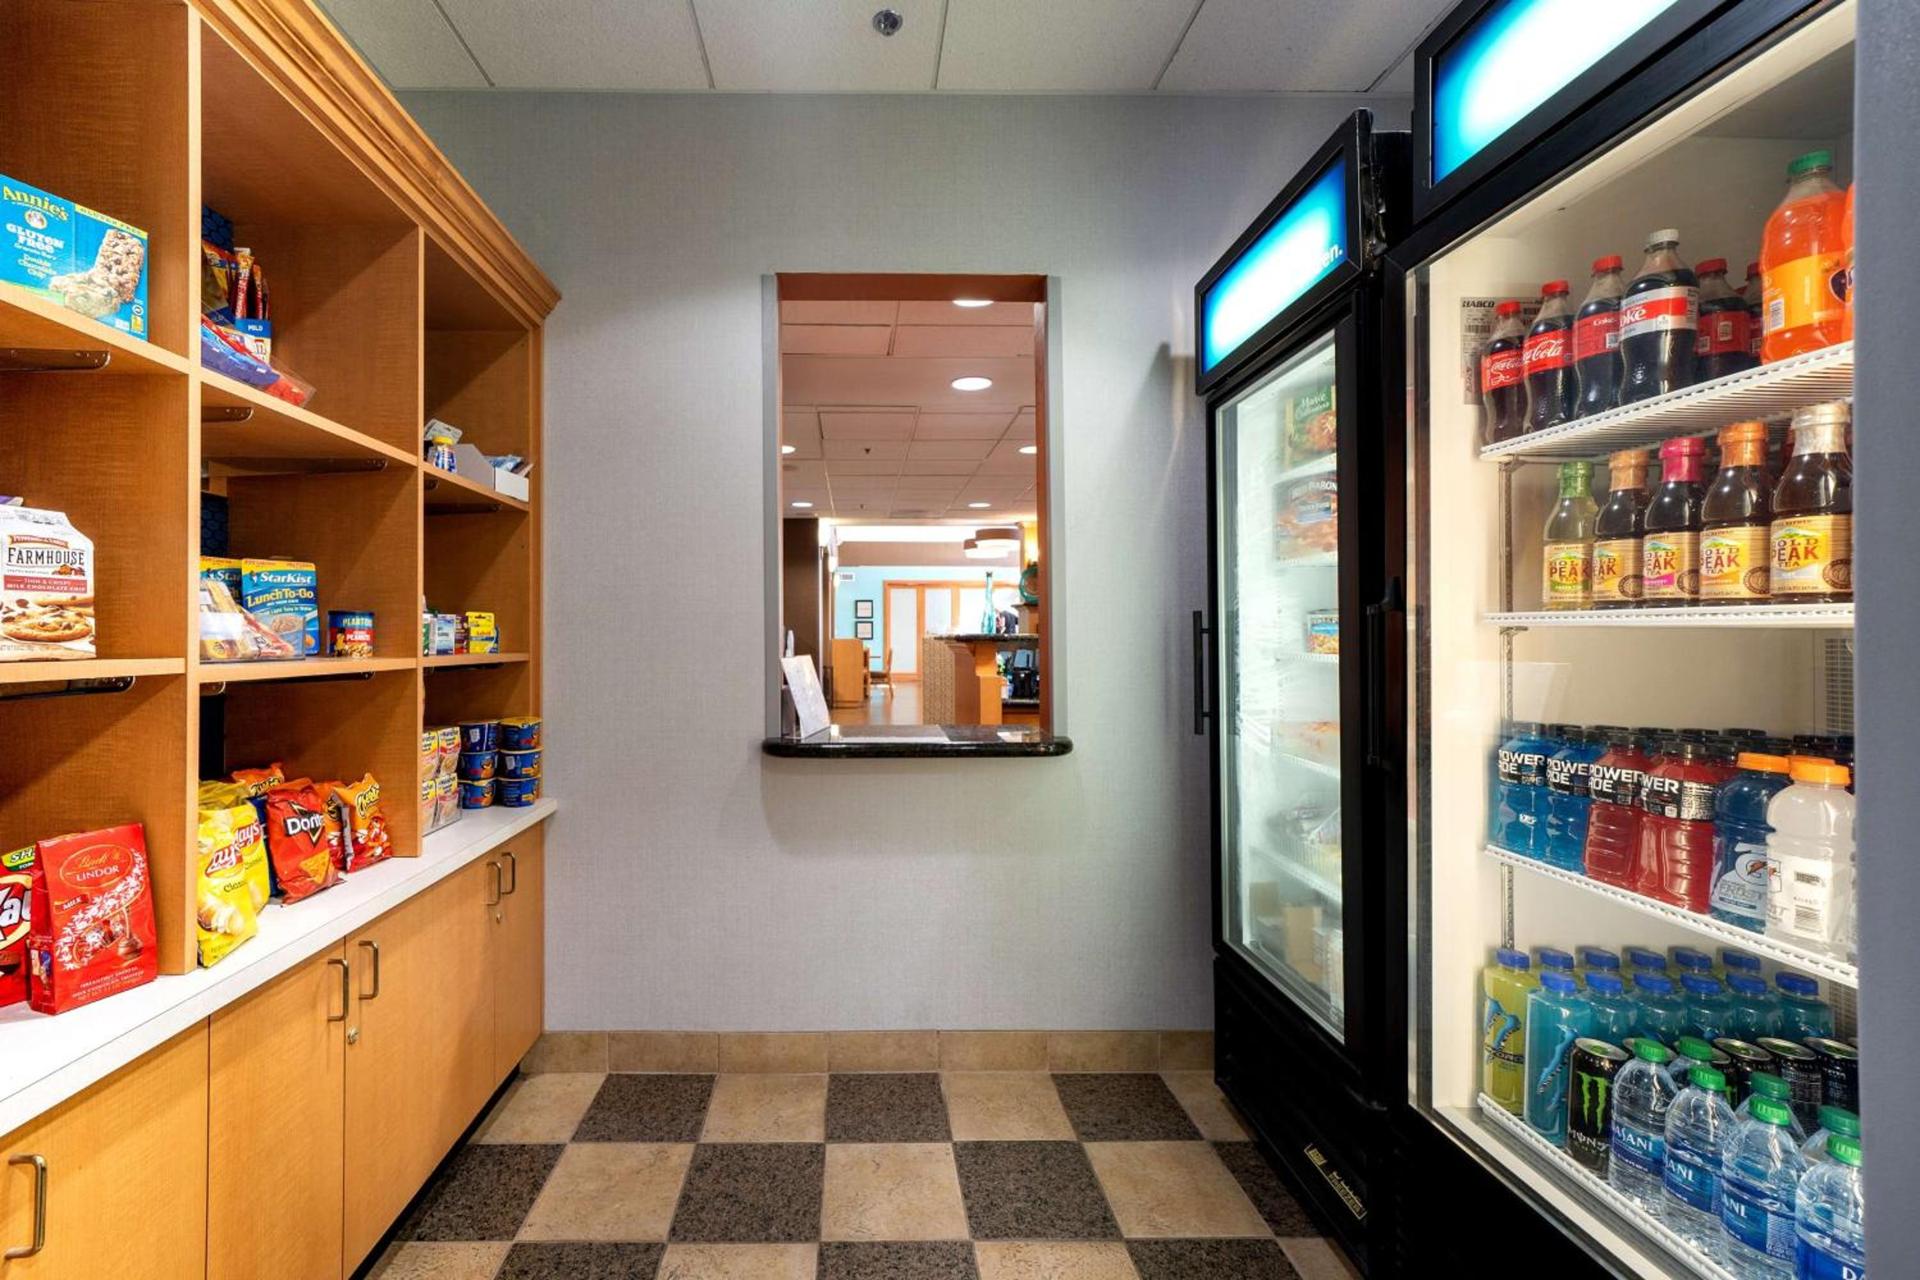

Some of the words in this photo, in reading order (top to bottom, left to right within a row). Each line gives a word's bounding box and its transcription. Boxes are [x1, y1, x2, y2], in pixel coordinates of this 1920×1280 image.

[6, 222, 65, 249] GLUTEN
[18, 233, 55, 254] FREE
[8, 547, 85, 566] FARMHOUSE
[261, 571, 312, 583] StarKist
[1549, 566, 1591, 578] PEAK
[246, 588, 283, 608] Lunch
[1499, 748, 1545, 767] OWER
[76, 865, 120, 882] LINDOR
[63, 895, 82, 911] MILK
[1613, 1125, 1653, 1152] ASANI
